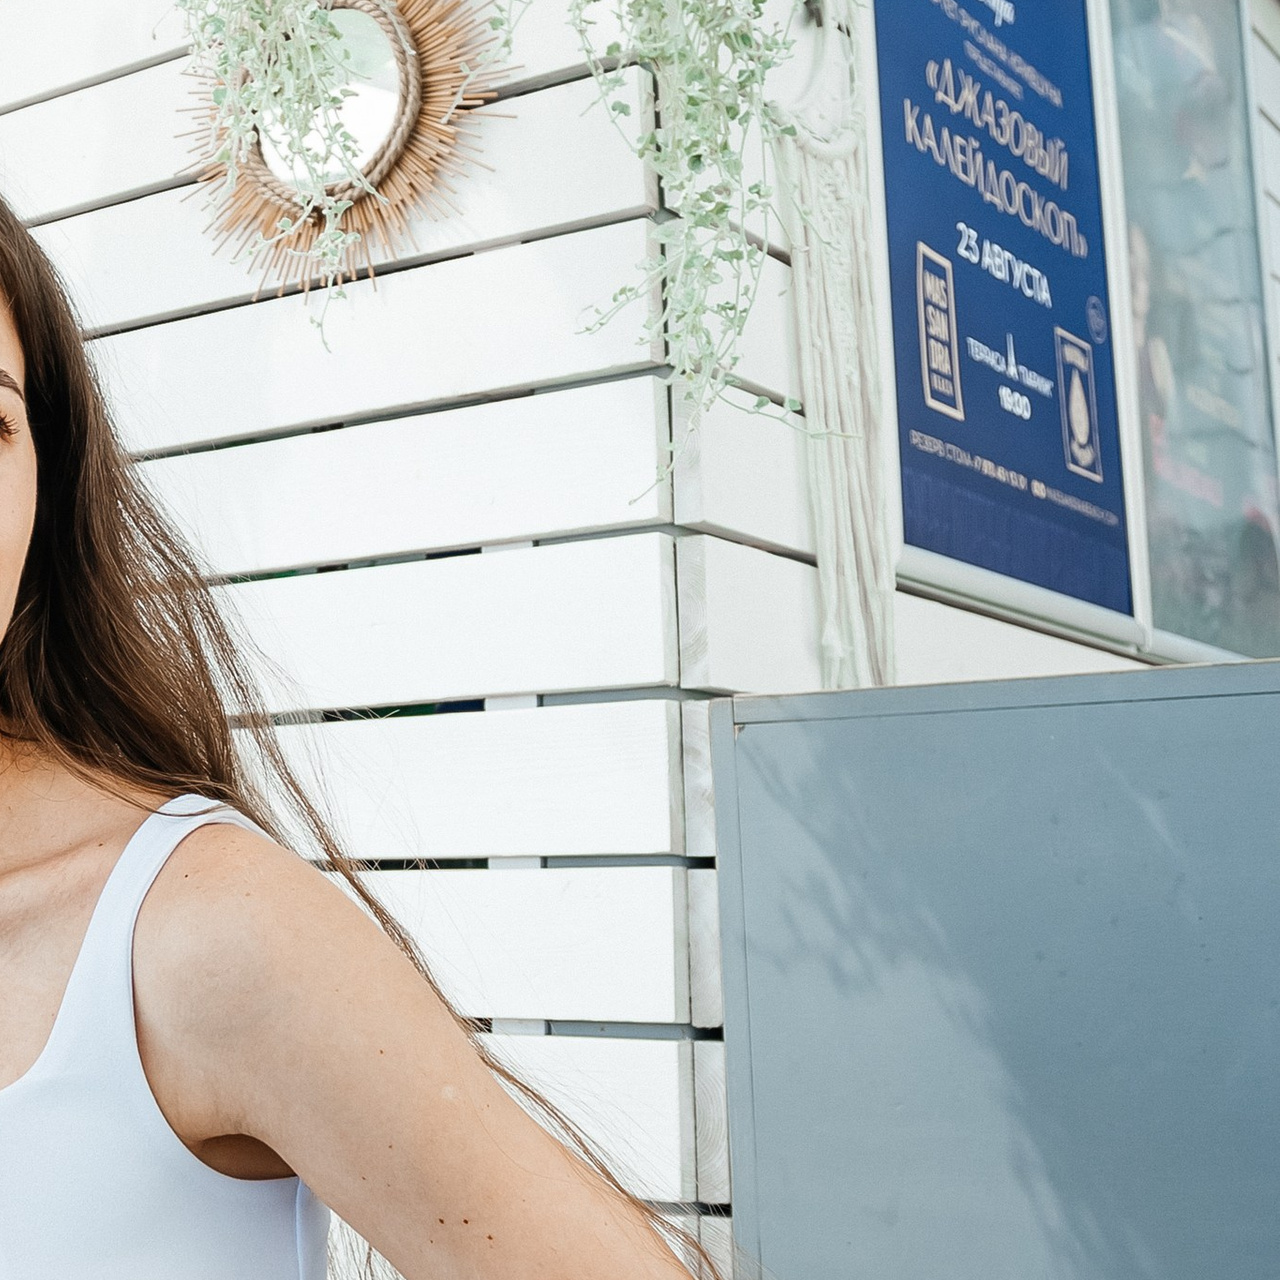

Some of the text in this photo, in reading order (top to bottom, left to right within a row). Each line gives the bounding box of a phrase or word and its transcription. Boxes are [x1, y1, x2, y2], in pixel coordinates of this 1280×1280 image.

[904, 98, 1087, 258] КАЛЕЙДОСКОП»
[957, 222, 1052, 308] 23 АВГУСТА
